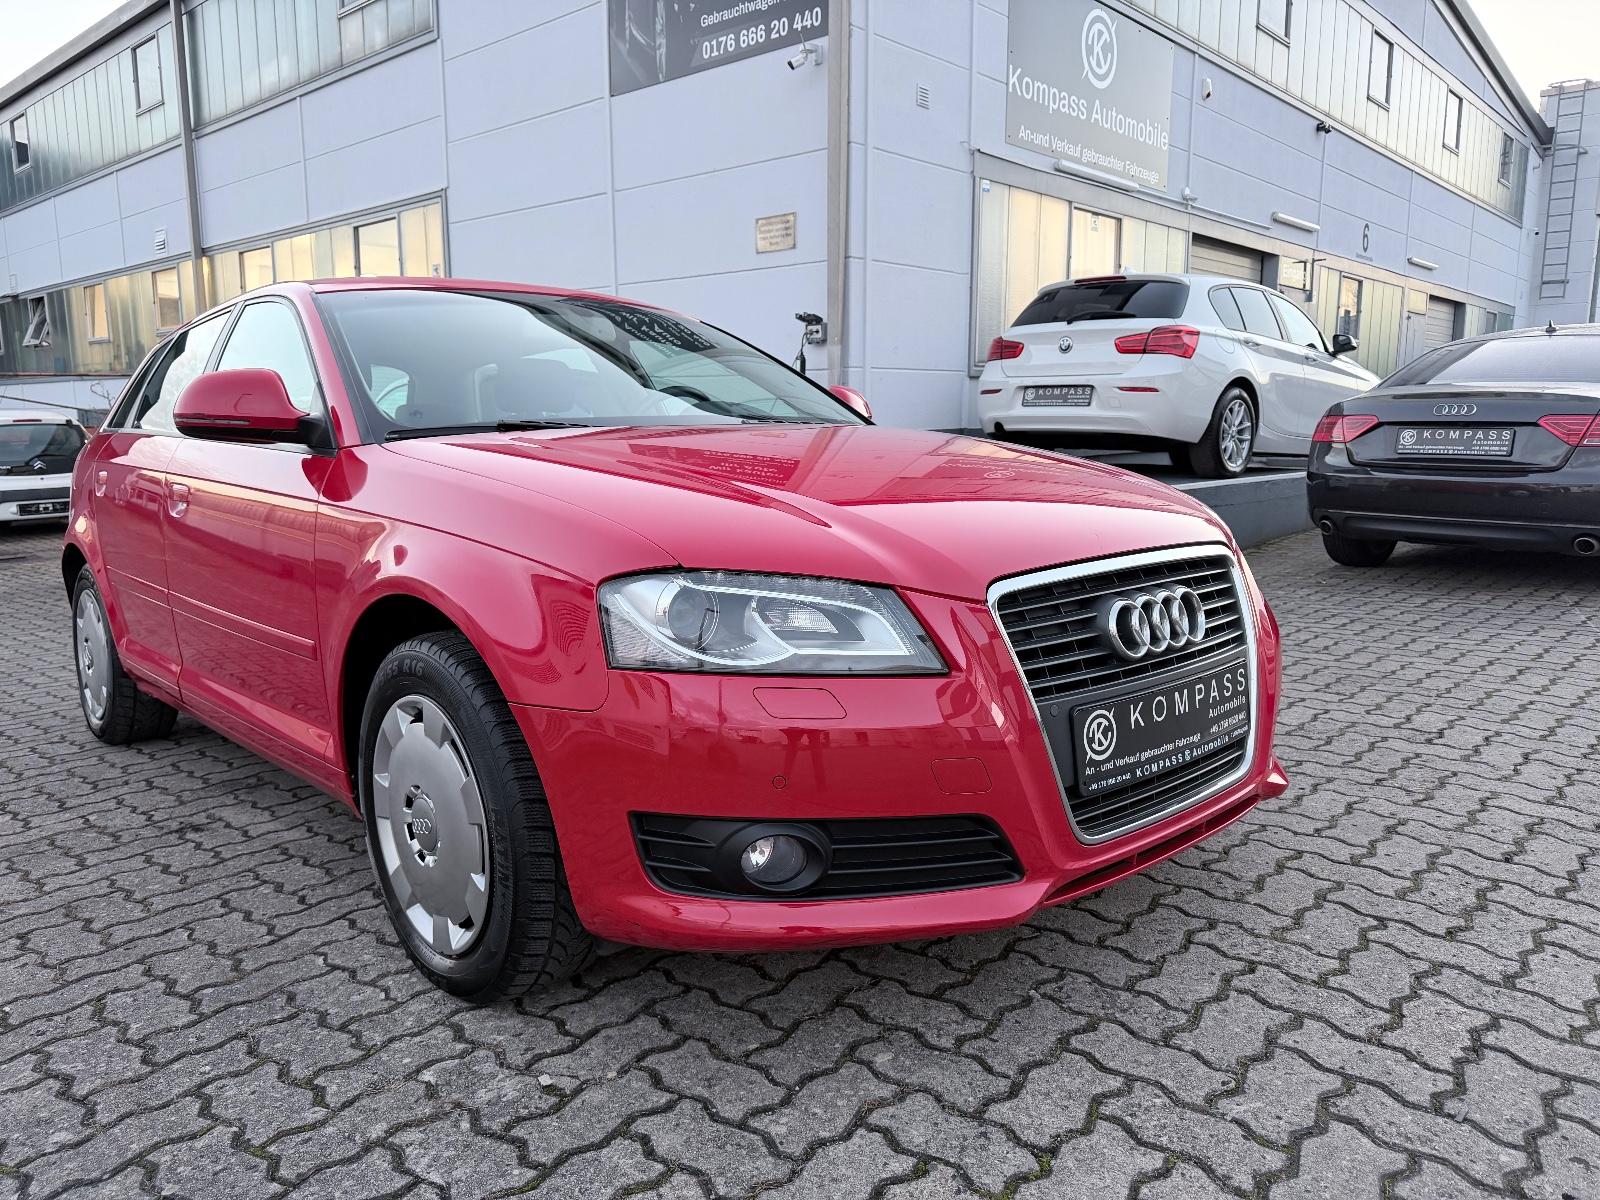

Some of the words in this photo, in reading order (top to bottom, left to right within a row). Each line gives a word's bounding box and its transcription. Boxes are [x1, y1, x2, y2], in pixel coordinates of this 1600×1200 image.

[702, 34, 735, 59] 0176
[740, 24, 766, 48] 666
[770, 17, 788, 39] 20
[793, 7, 822, 31] 440
[1008, 64, 1087, 120] Kompass
[1091, 100, 1169, 150] Automobile
[1018, 125, 1050, 147] An-und
[1051, 135, 1081, 158] Verkauf
[1082, 147, 1125, 171] gebrauchter
[1125, 161, 1159, 183] Fahrzeuge
[1362, 223, 1370, 253] 6
[1039, 387, 1091, 395] KOMPASS
[1423, 430, 1511, 440] KOMPASS
[1130, 668, 1246, 730] KOMPASS
[1208, 694, 1246, 719] Automobile
[1085, 766, 1095, 775] An
[1100, 760, 1114, 772] und
[1115, 752, 1140, 767] Verkauf
[1140, 742, 1175, 761] gebrauchter
[1136, 753, 1183, 778] KOMPASS
[1192, 735, 1229, 758] Automobile
